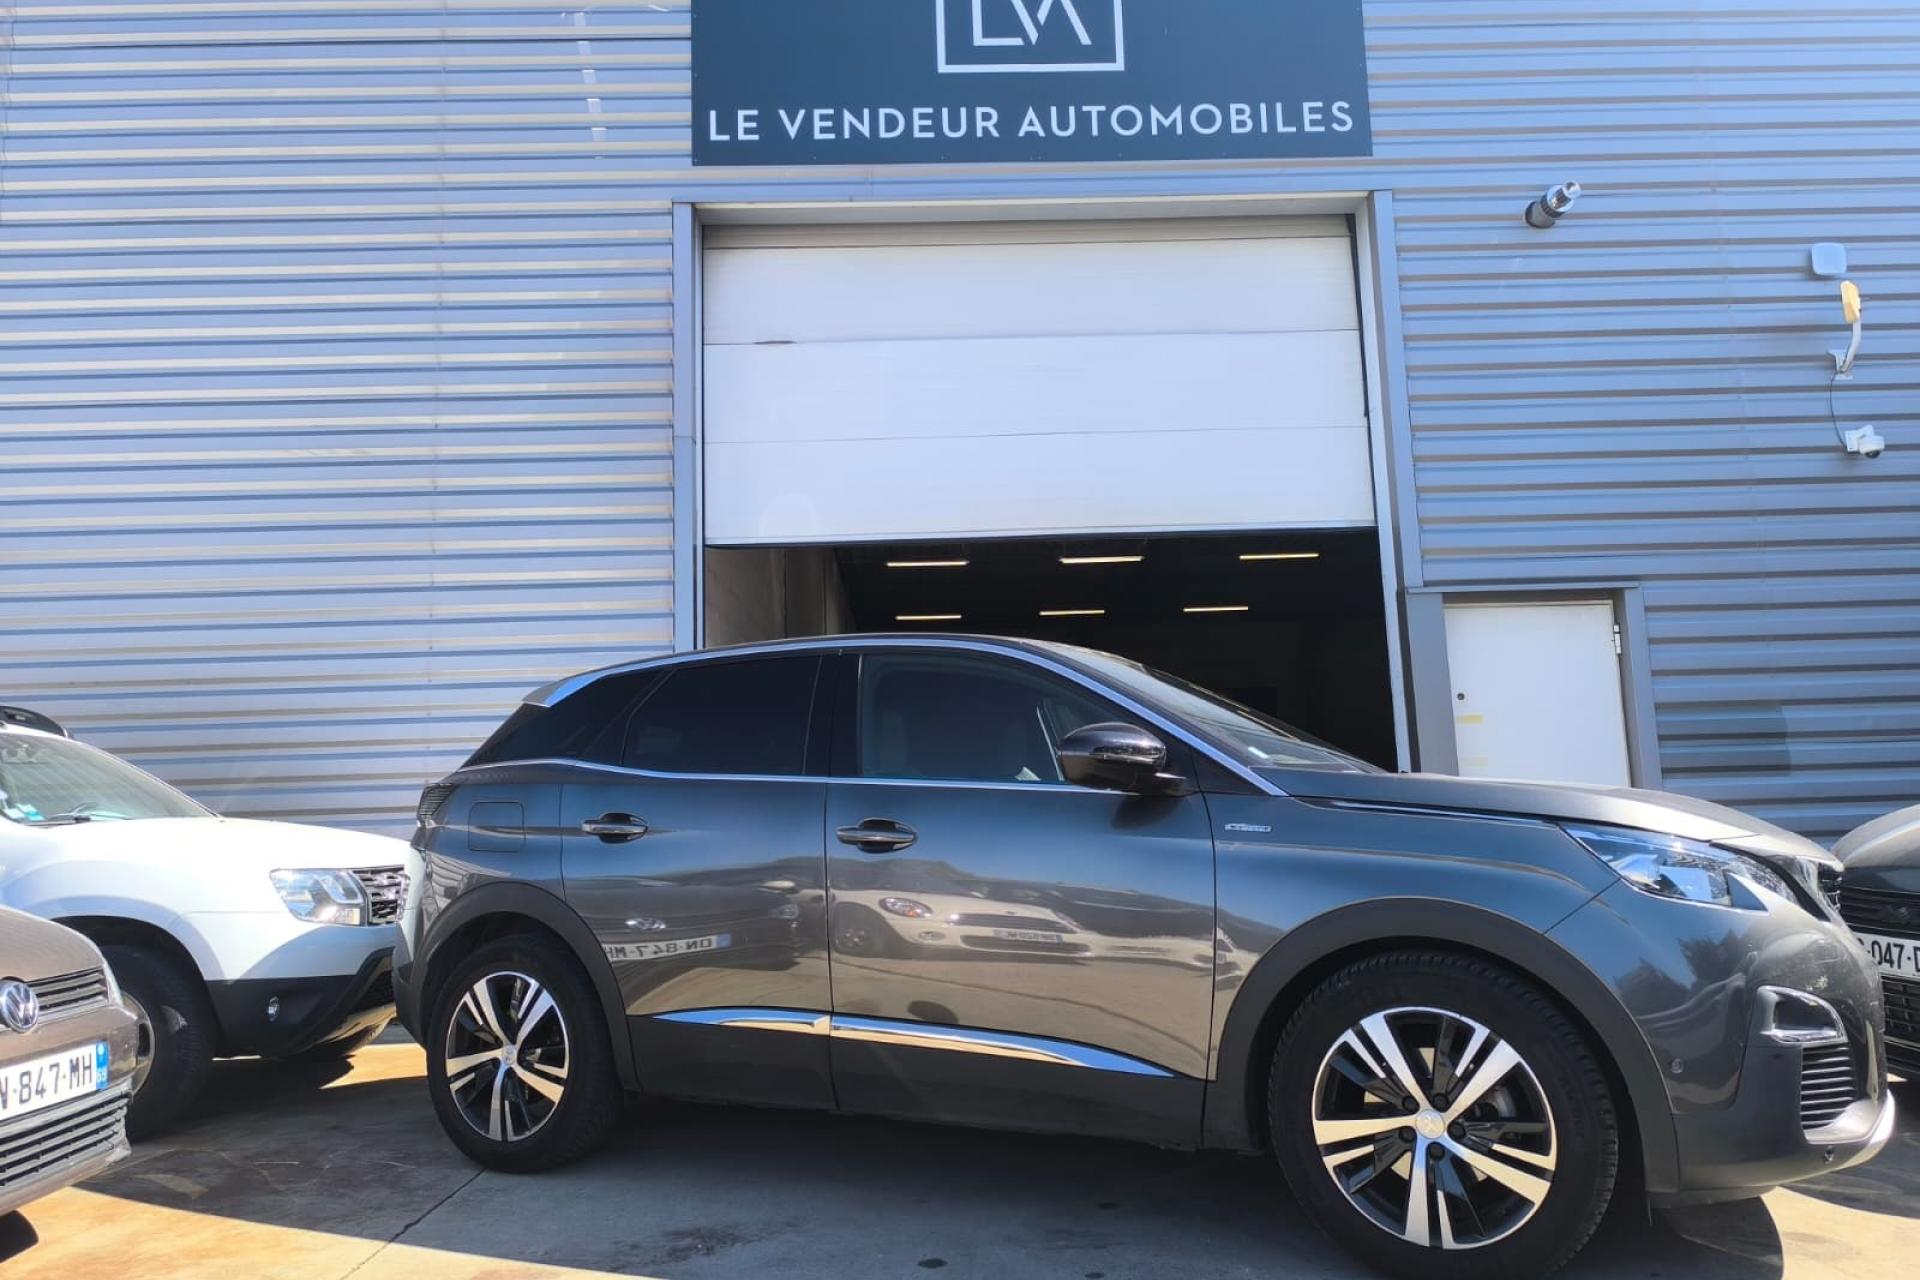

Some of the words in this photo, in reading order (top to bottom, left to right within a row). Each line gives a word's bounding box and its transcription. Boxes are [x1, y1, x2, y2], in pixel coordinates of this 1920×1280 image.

[709, 109, 760, 141] LE
[778, 106, 1000, 140] VENDEUR
[1018, 101, 1353, 137] AUTOMOBILES
